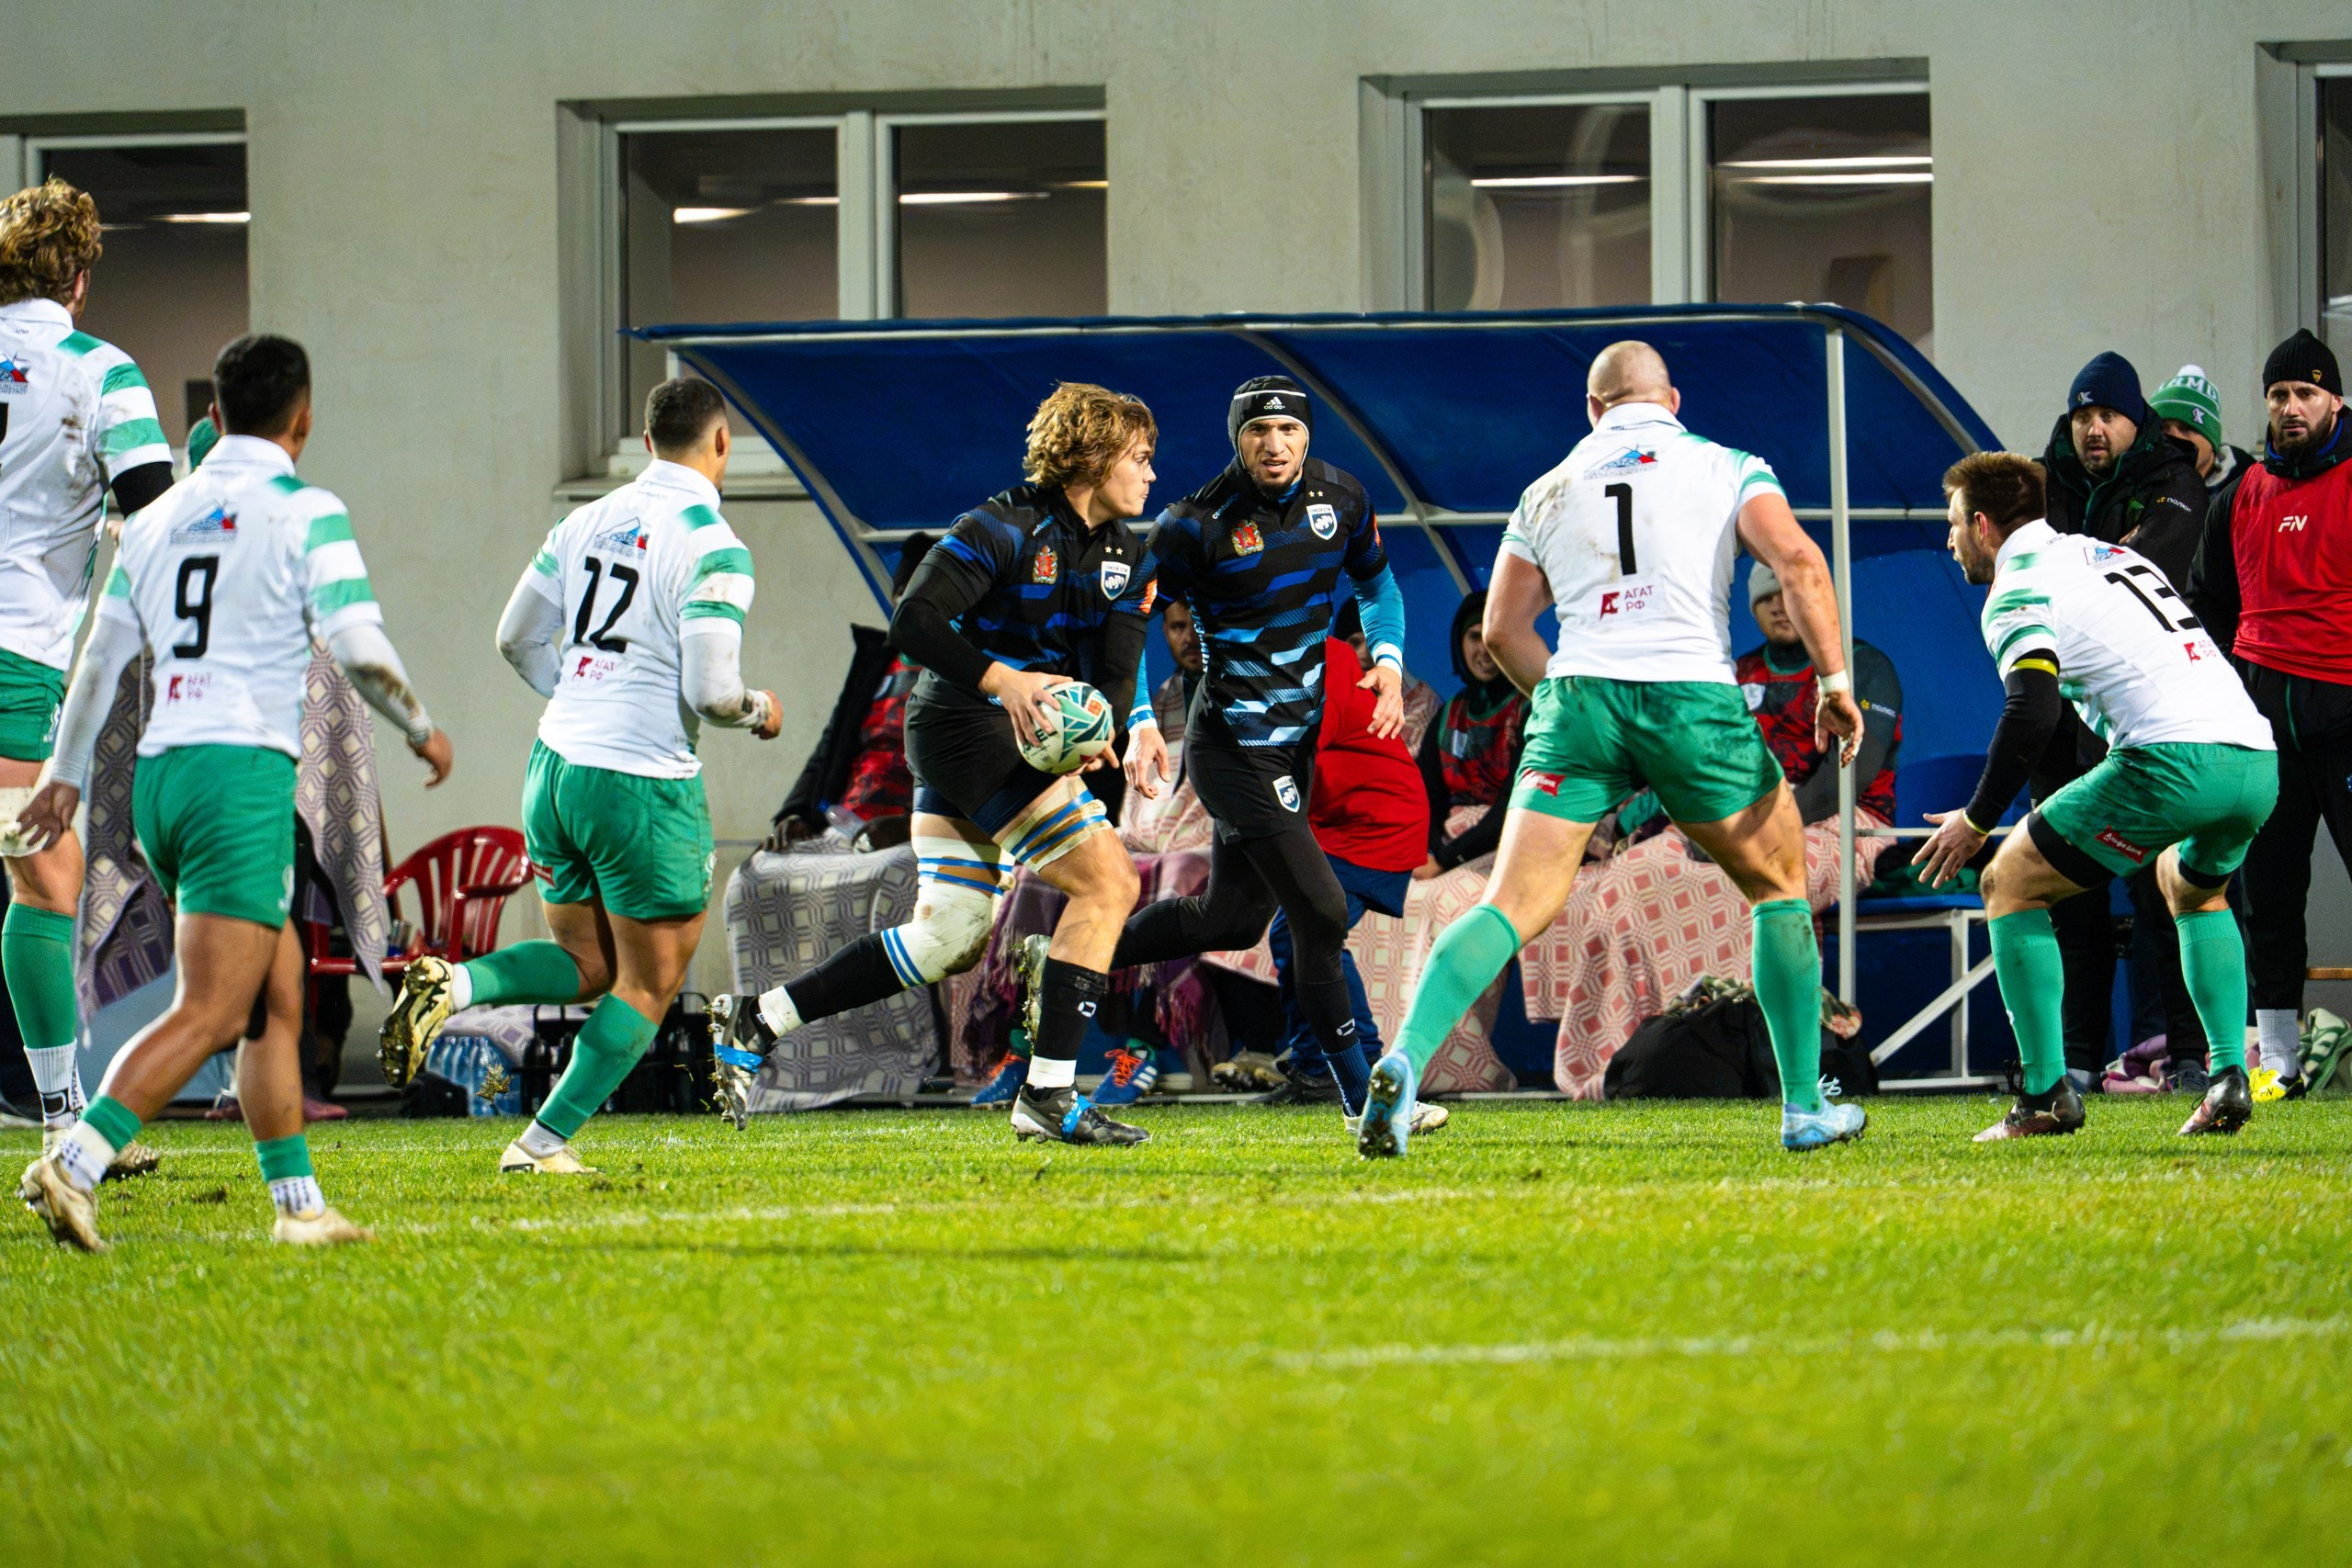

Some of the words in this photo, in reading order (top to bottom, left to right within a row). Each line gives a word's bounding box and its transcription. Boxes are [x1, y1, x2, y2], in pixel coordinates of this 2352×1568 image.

[1605, 482, 1637, 576] 1
[172, 556, 220, 659] 9
[572, 556, 640, 654] 12
[1624, 585, 1654, 600] АГАТ
[1625, 600, 1645, 613] РФ
[2103, 564, 2203, 633] 13
